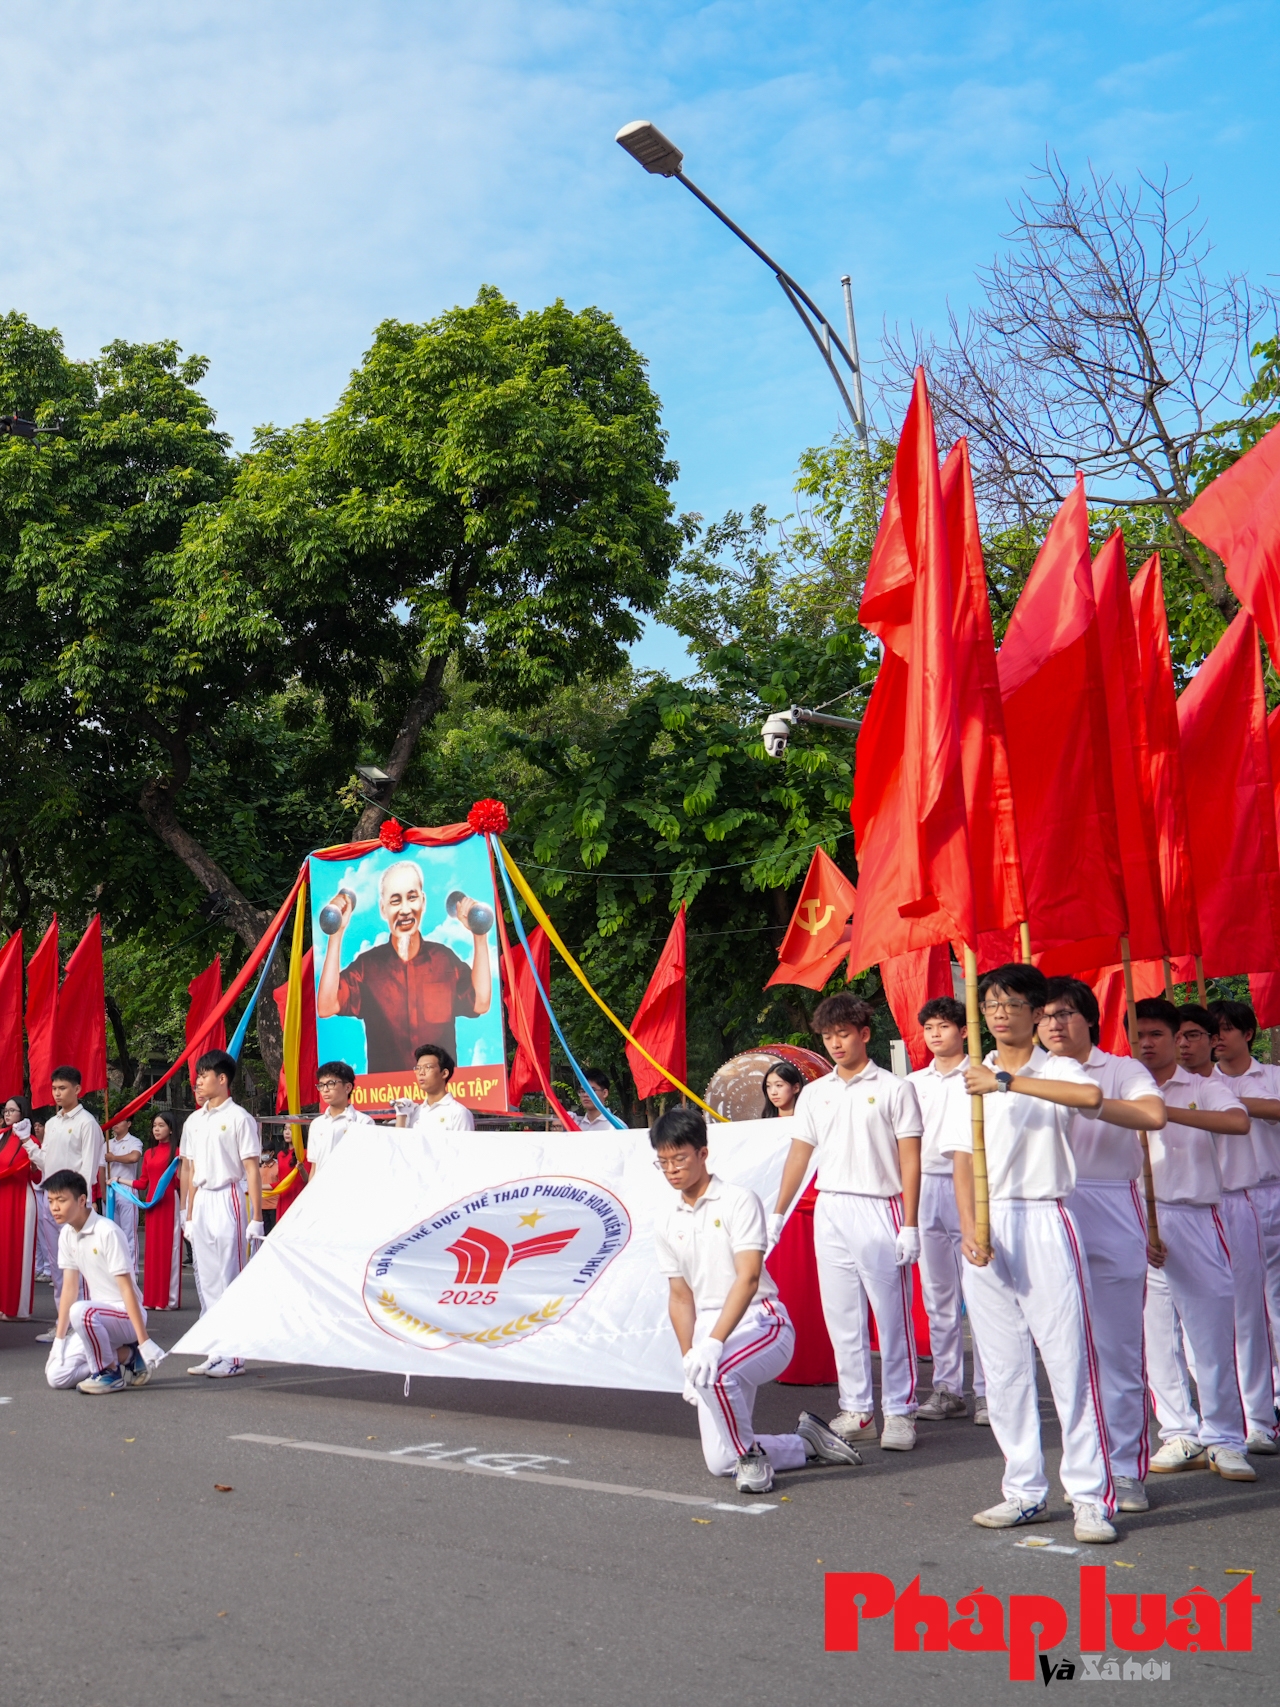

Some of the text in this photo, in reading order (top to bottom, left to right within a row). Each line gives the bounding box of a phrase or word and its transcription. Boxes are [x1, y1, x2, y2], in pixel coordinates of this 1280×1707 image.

[370, 1080, 401, 1103] NGÀY
[447, 1081, 466, 1098] NG
[493, 1186, 529, 1204] THAO
[532, 1183, 588, 1202] PHƯỜNG
[463, 1192, 489, 1214] THỂ
[584, 1194, 614, 1218] HOÀN
[431, 1211, 461, 1229] DỤC
[602, 1214, 626, 1239] KIẾM
[405, 1225, 432, 1243] THỂ
[384, 1242, 408, 1256] HỘI
[596, 1238, 622, 1255] LẦN
[376, 1258, 393, 1276] ĐẠI
[438, 1290, 499, 1305] 2025
